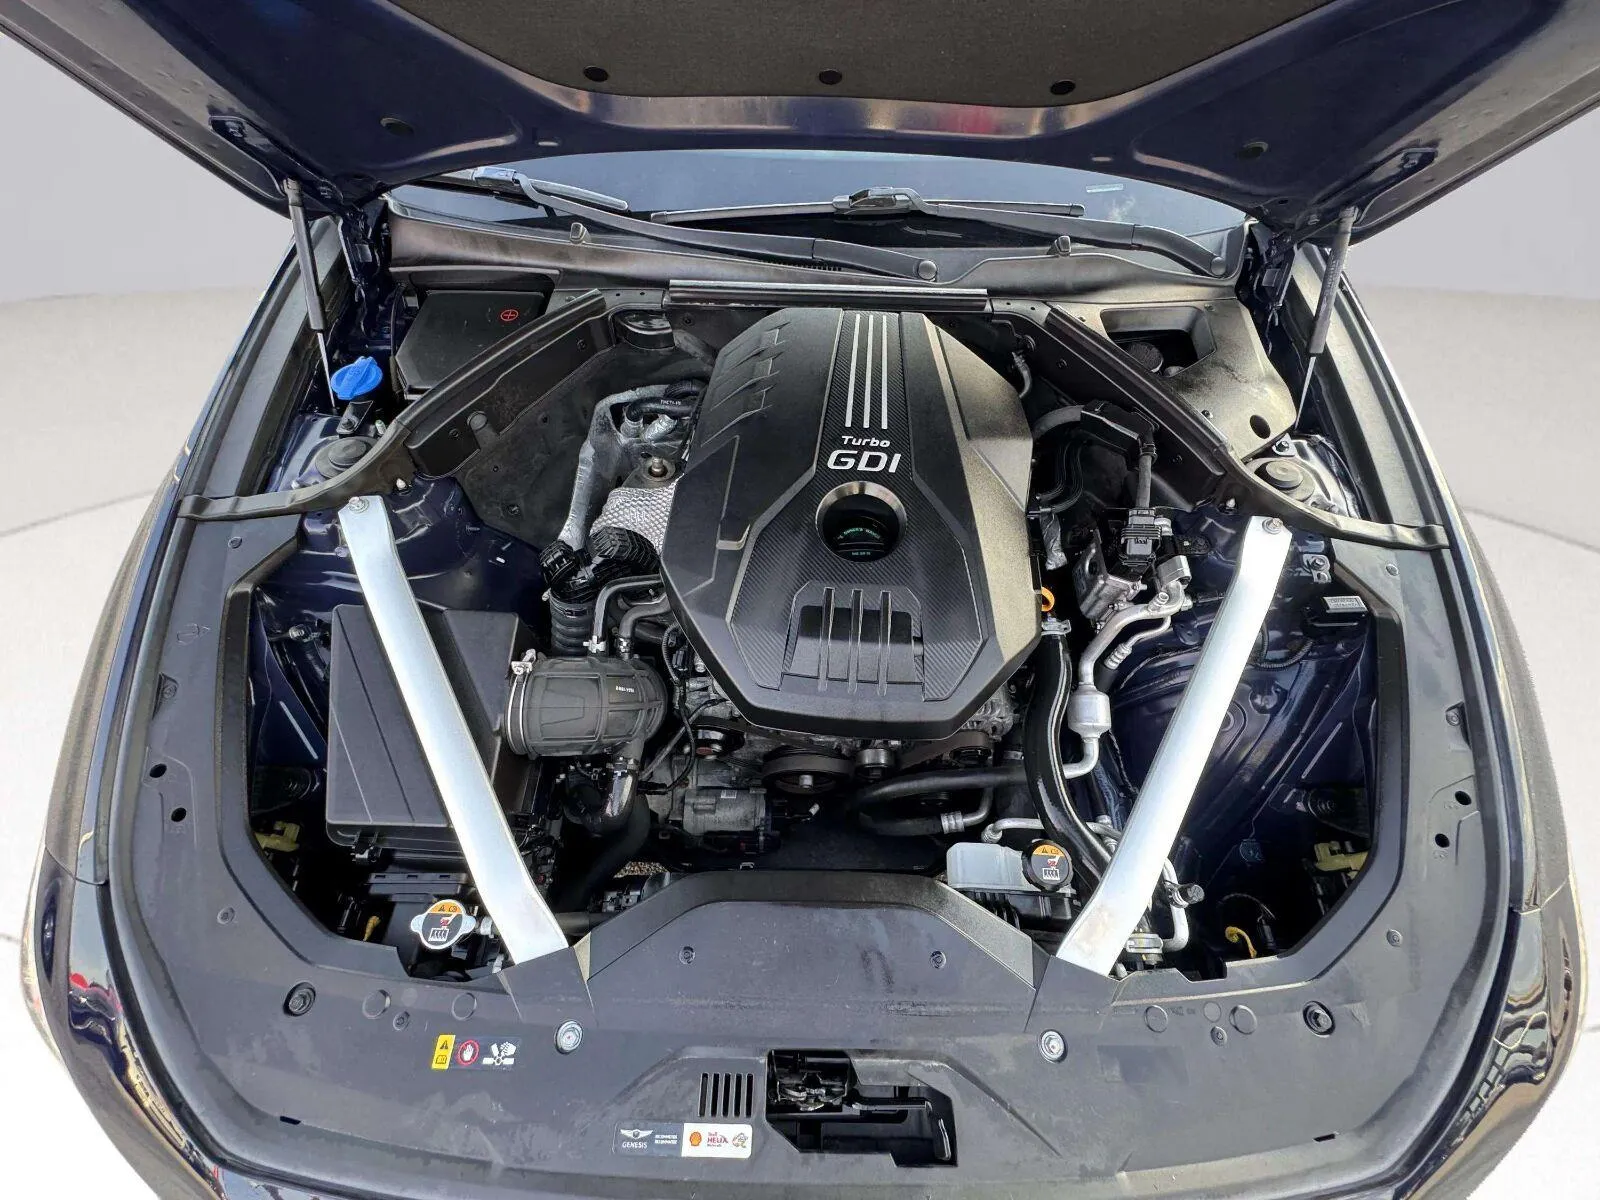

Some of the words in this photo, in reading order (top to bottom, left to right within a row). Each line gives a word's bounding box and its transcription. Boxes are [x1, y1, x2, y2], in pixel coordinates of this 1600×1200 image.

[841, 435, 891, 448] Turbo
[827, 449, 902, 473] GDI
[621, 1141, 648, 1149] GENESIS
[706, 1135, 729, 1144] HELIX
